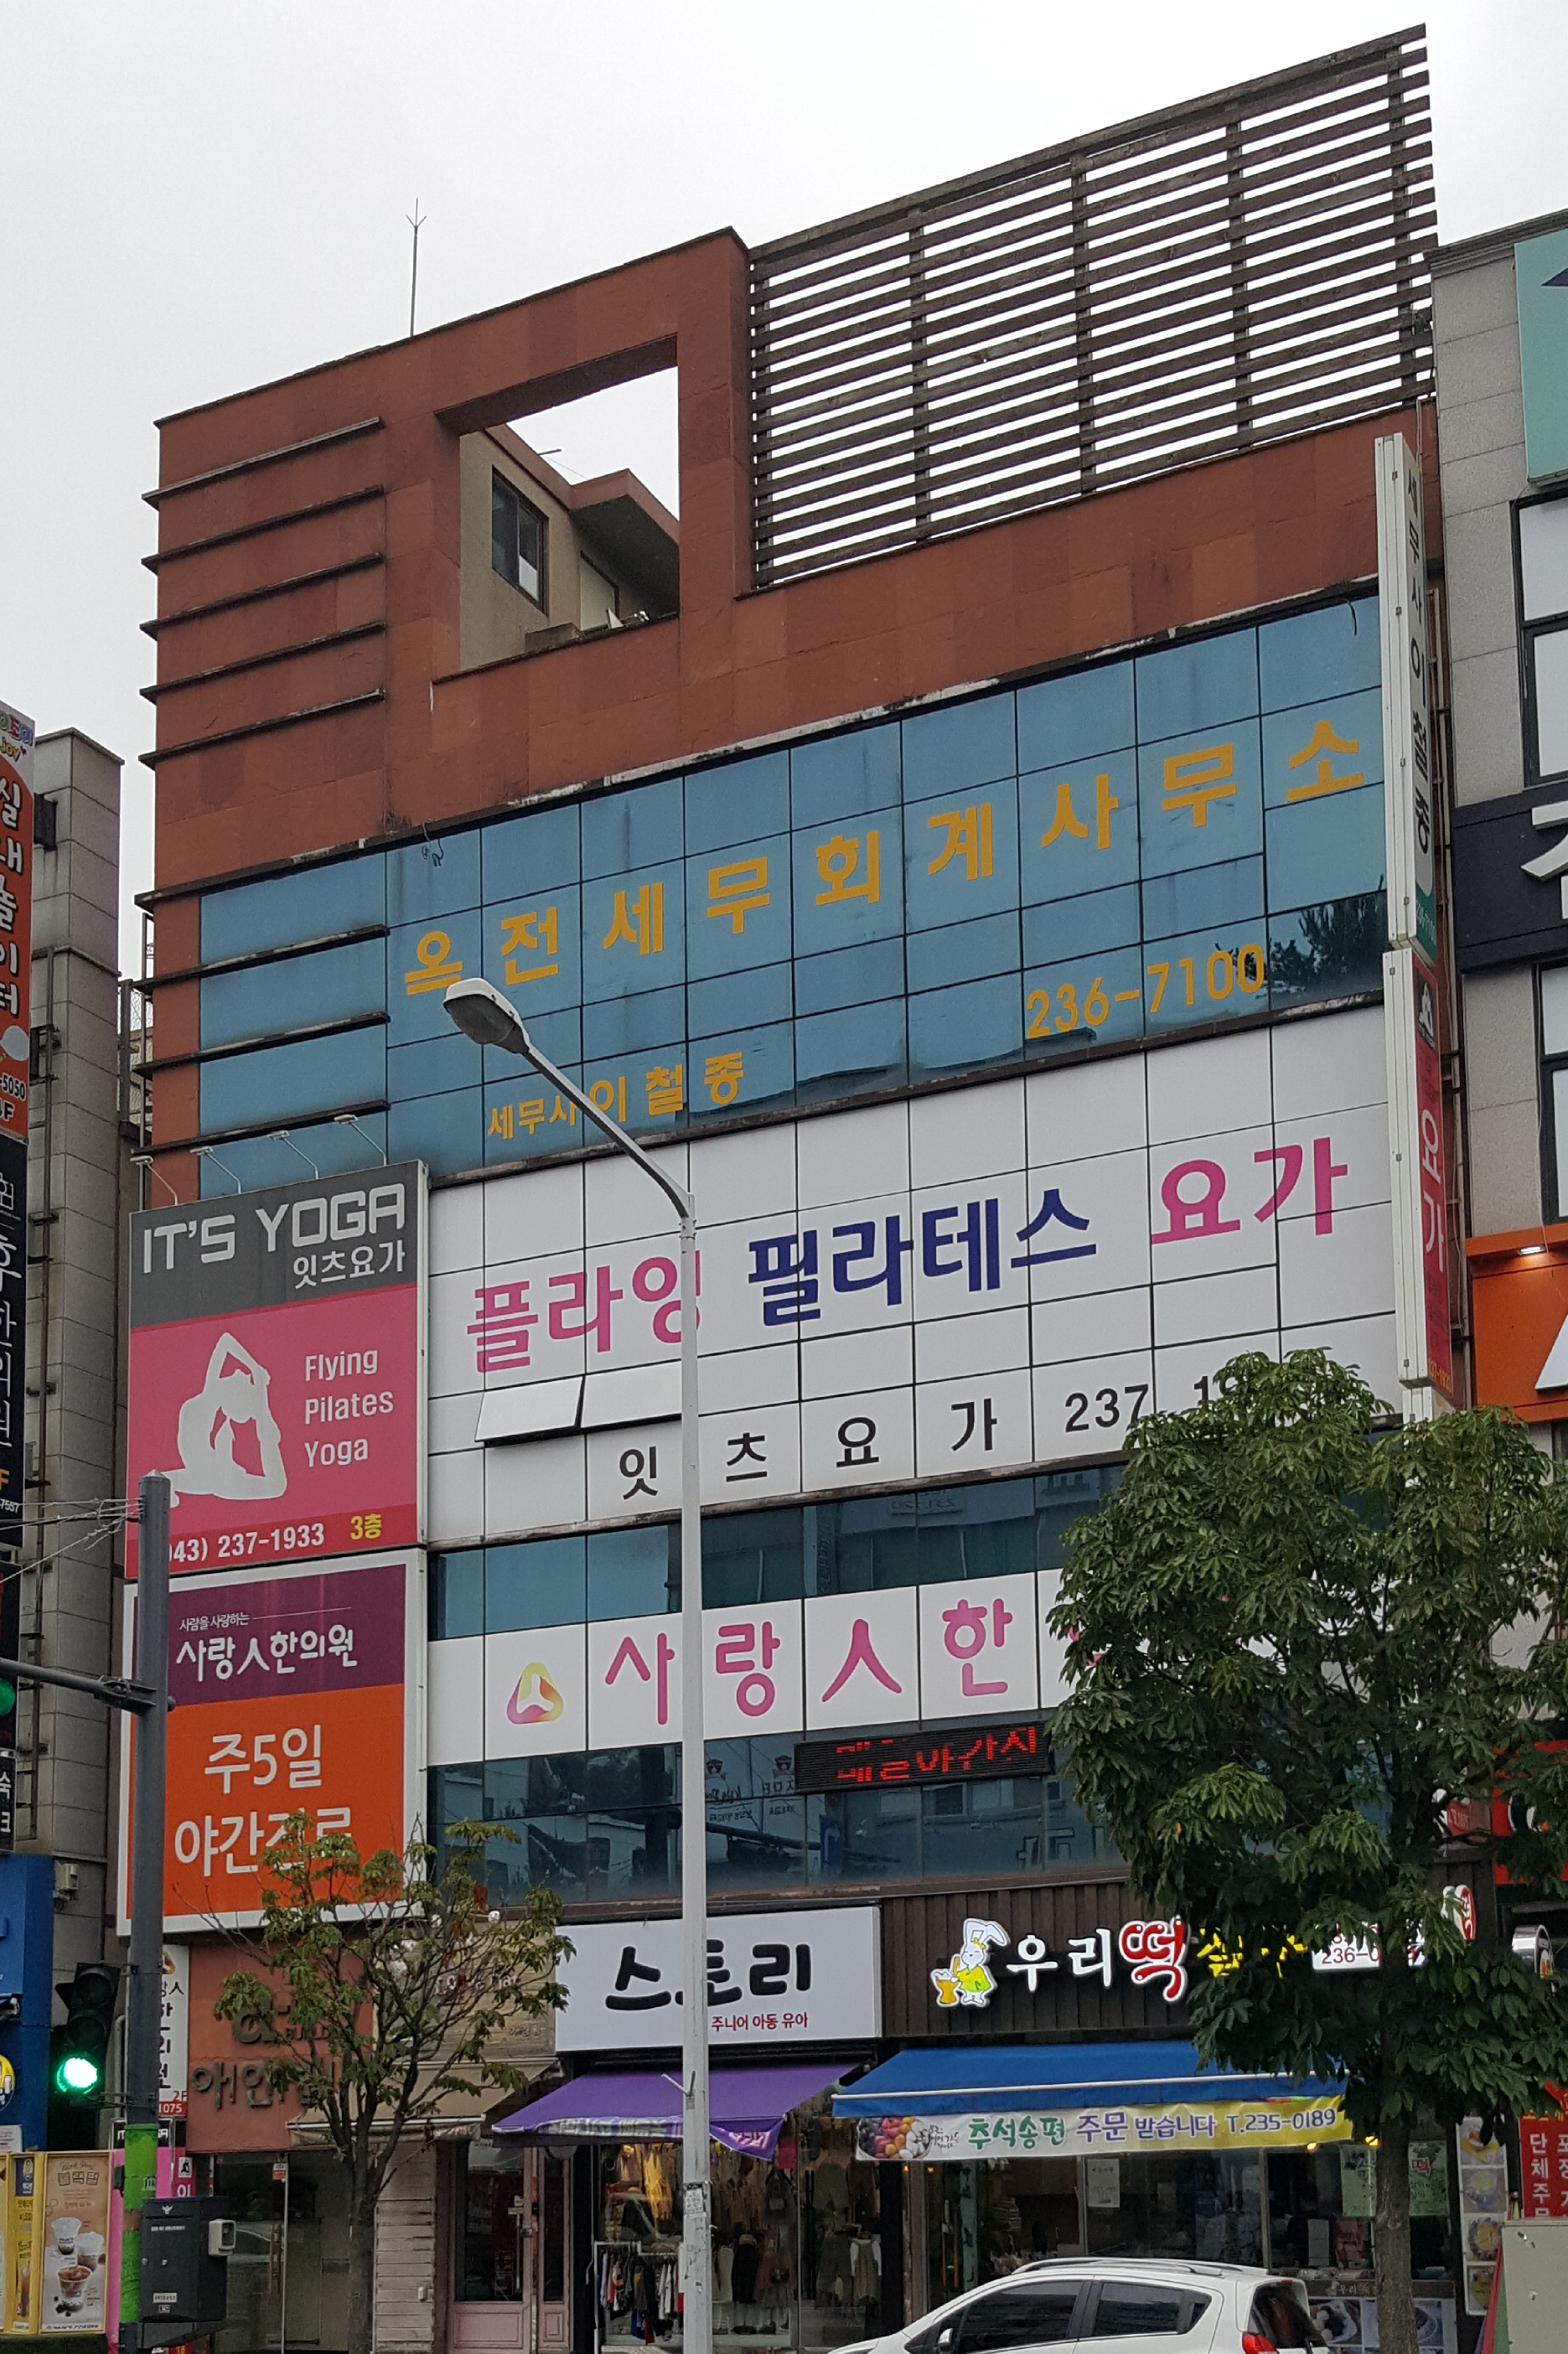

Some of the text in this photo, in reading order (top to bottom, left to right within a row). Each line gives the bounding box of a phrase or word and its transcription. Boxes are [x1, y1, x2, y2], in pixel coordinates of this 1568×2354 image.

[1026, 942, 1265, 1040] 236-7100
[487, 1051, 745, 1141] 세무사 이철종
[143, 1182, 406, 1274] IT'S YOGA
[292, 1239, 406, 1290] 잇츠요가
[467, 1136, 1348, 1374] 플라잉 필라테스 요가
[304, 1348, 379, 1383] Flying
[304, 1390, 394, 1425] Pilates
[1064, 1383, 1150, 1434] 237
[303, 1438, 370, 1468] Yoga
[217, 1523, 325, 1560] 237-1933
[349, 1513, 383, 1541] 3층
[179, 1611, 251, 1632] 사람을 사랑하는
[204, 1724, 323, 1795] 주5일
[711, 2011, 809, 2032] 주니어 아동 유아
[968, 2115, 1065, 2150] 추석송편
[1076, 2111, 1129, 2144] 주문
[1134, 2113, 1216, 2139] 받습니다
[1225, 2108, 1337, 2134] T.235-0189
